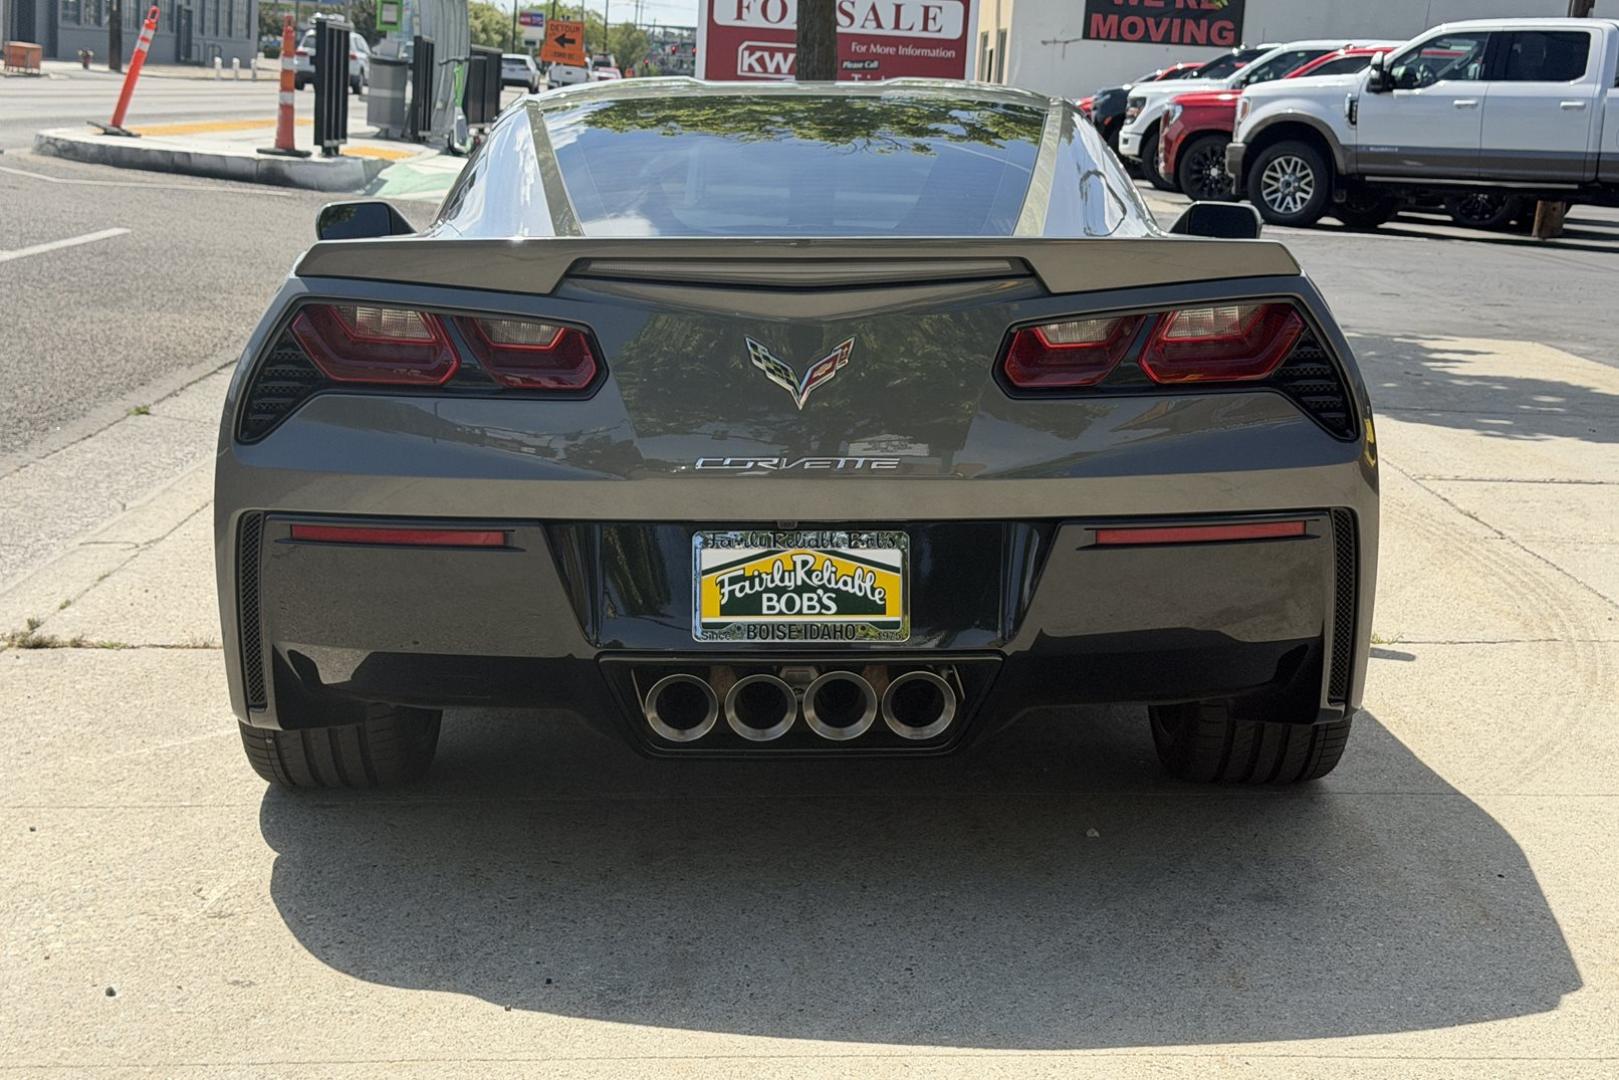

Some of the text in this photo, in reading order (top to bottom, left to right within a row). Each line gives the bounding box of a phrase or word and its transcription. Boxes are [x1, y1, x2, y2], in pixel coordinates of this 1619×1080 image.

[733, 0, 943, 33] FO SALE
[1090, 13, 1235, 46] MOVING
[851, 41, 955, 58] For More Information
[741, 50, 796, 74] KW
[864, 61, 879, 69] Call
[695, 457, 900, 470] CORVETTE
[715, 553, 886, 605] Fairly Reliable
[762, 589, 837, 615] BOB'S
[702, 631, 731, 640] Since
